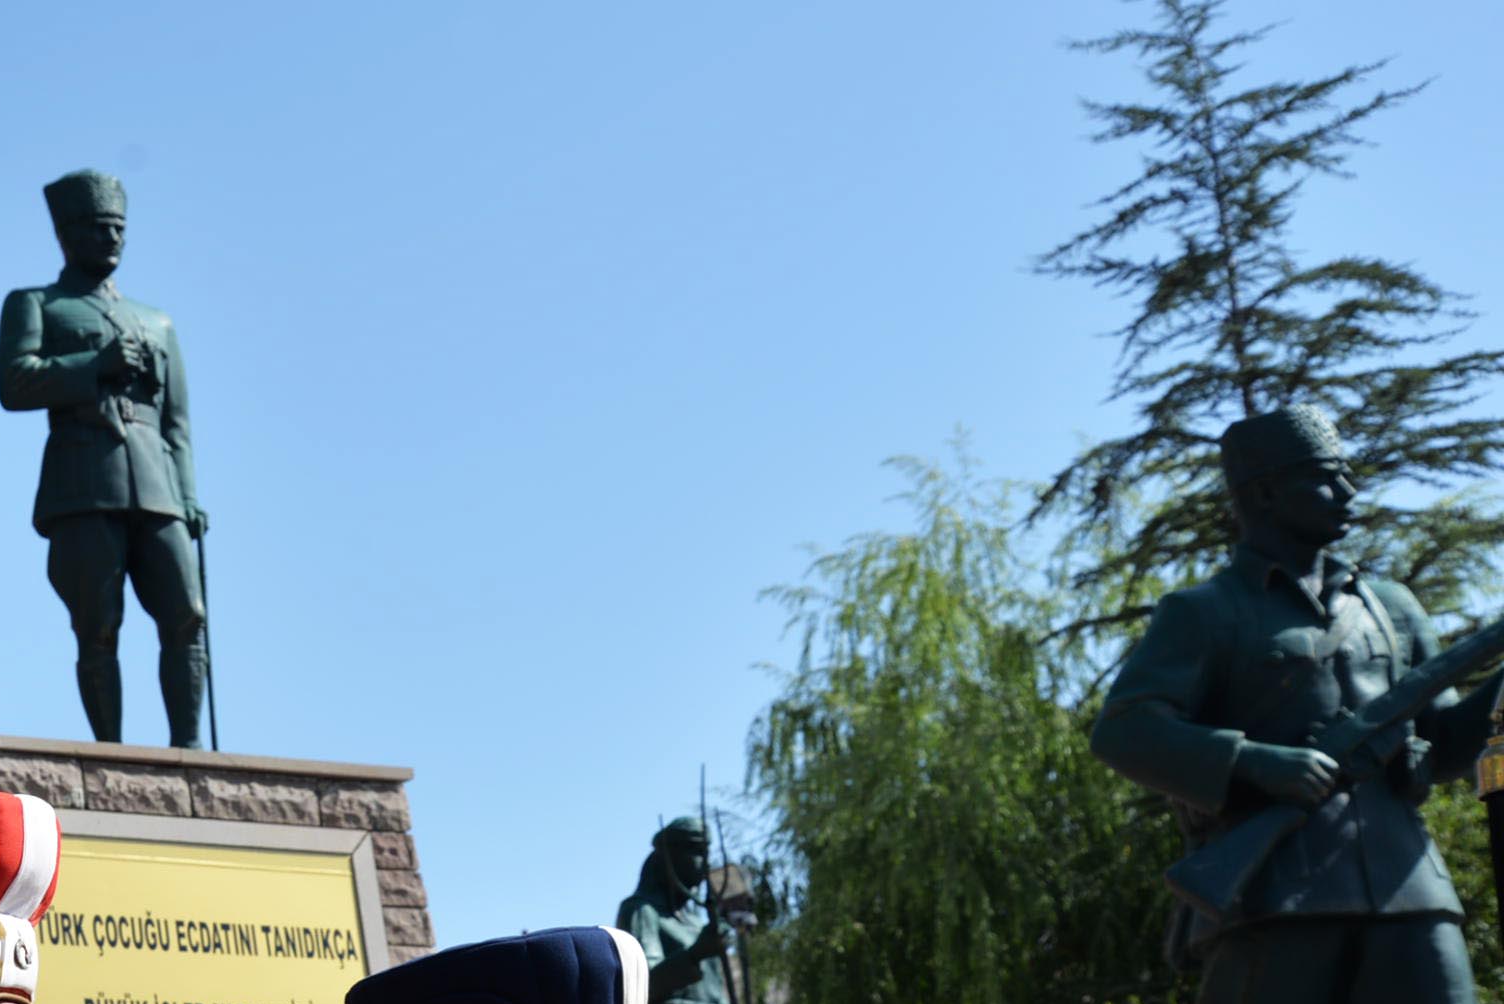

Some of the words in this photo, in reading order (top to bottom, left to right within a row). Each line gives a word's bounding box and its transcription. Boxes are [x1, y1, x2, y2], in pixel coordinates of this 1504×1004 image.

[39, 905, 88, 947] TÜRK
[92, 910, 170, 957] ÇOCUĞU
[176, 920, 259, 957] ECDATINI
[261, 924, 358, 970] TANIDIKÇA
